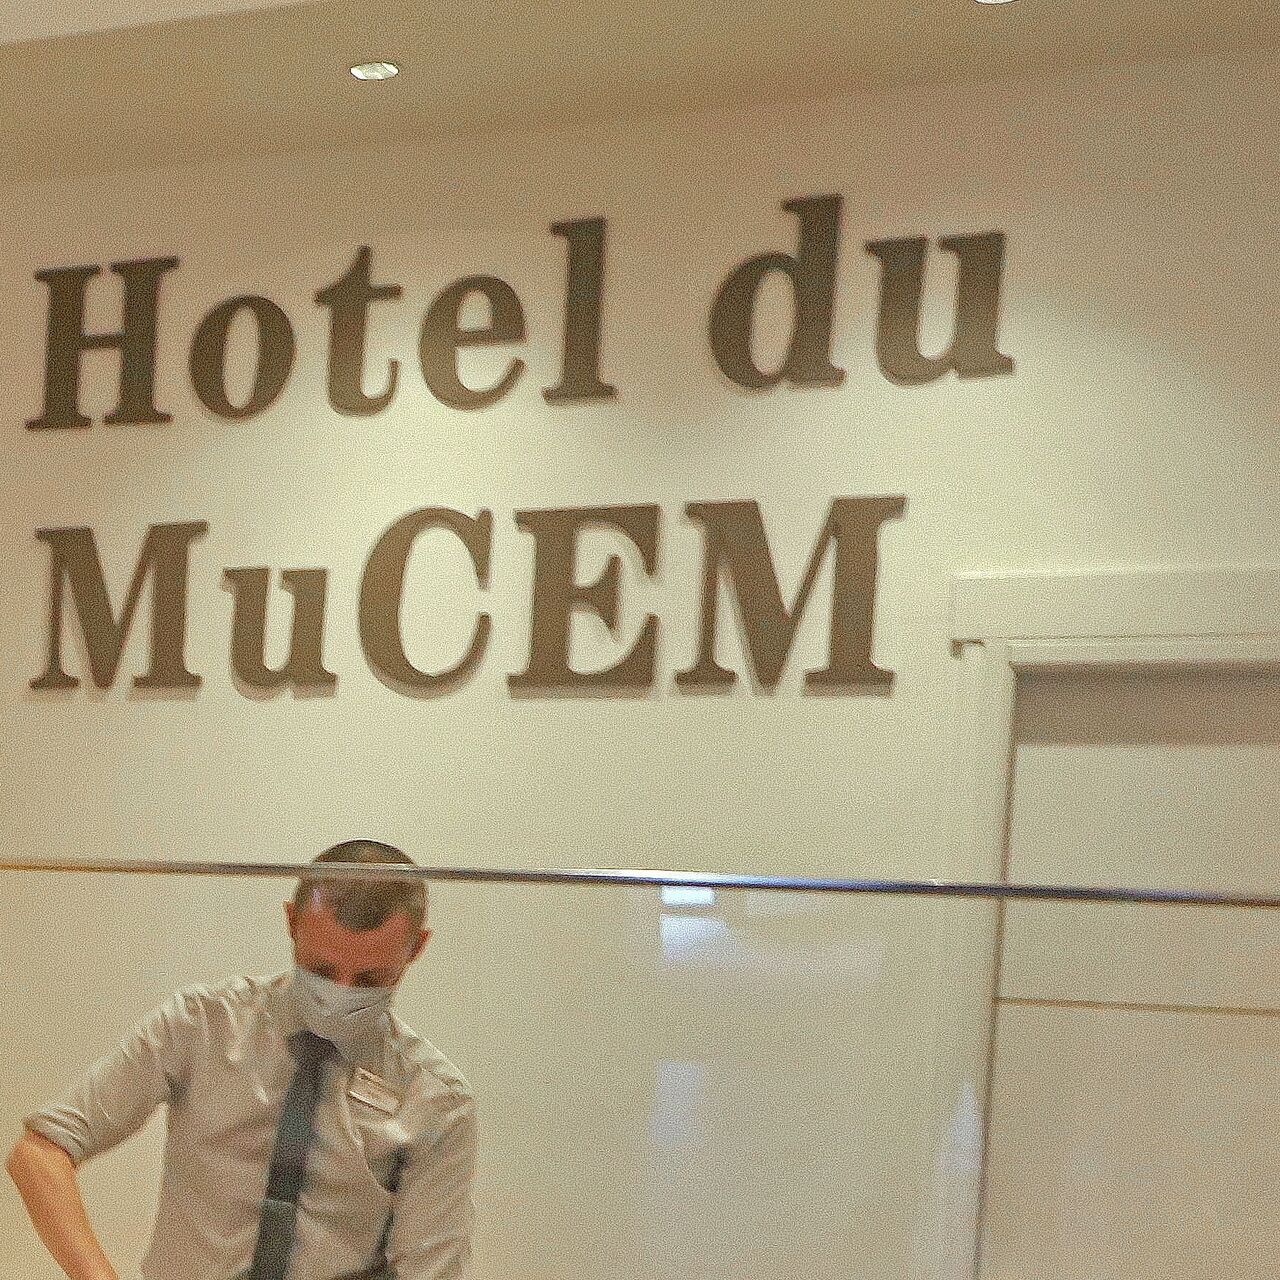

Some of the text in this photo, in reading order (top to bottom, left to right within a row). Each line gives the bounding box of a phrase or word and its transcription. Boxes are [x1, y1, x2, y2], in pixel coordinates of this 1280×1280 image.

[24, 192, 1014, 431] Hotel du
[27, 495, 907, 698] MuCEM
